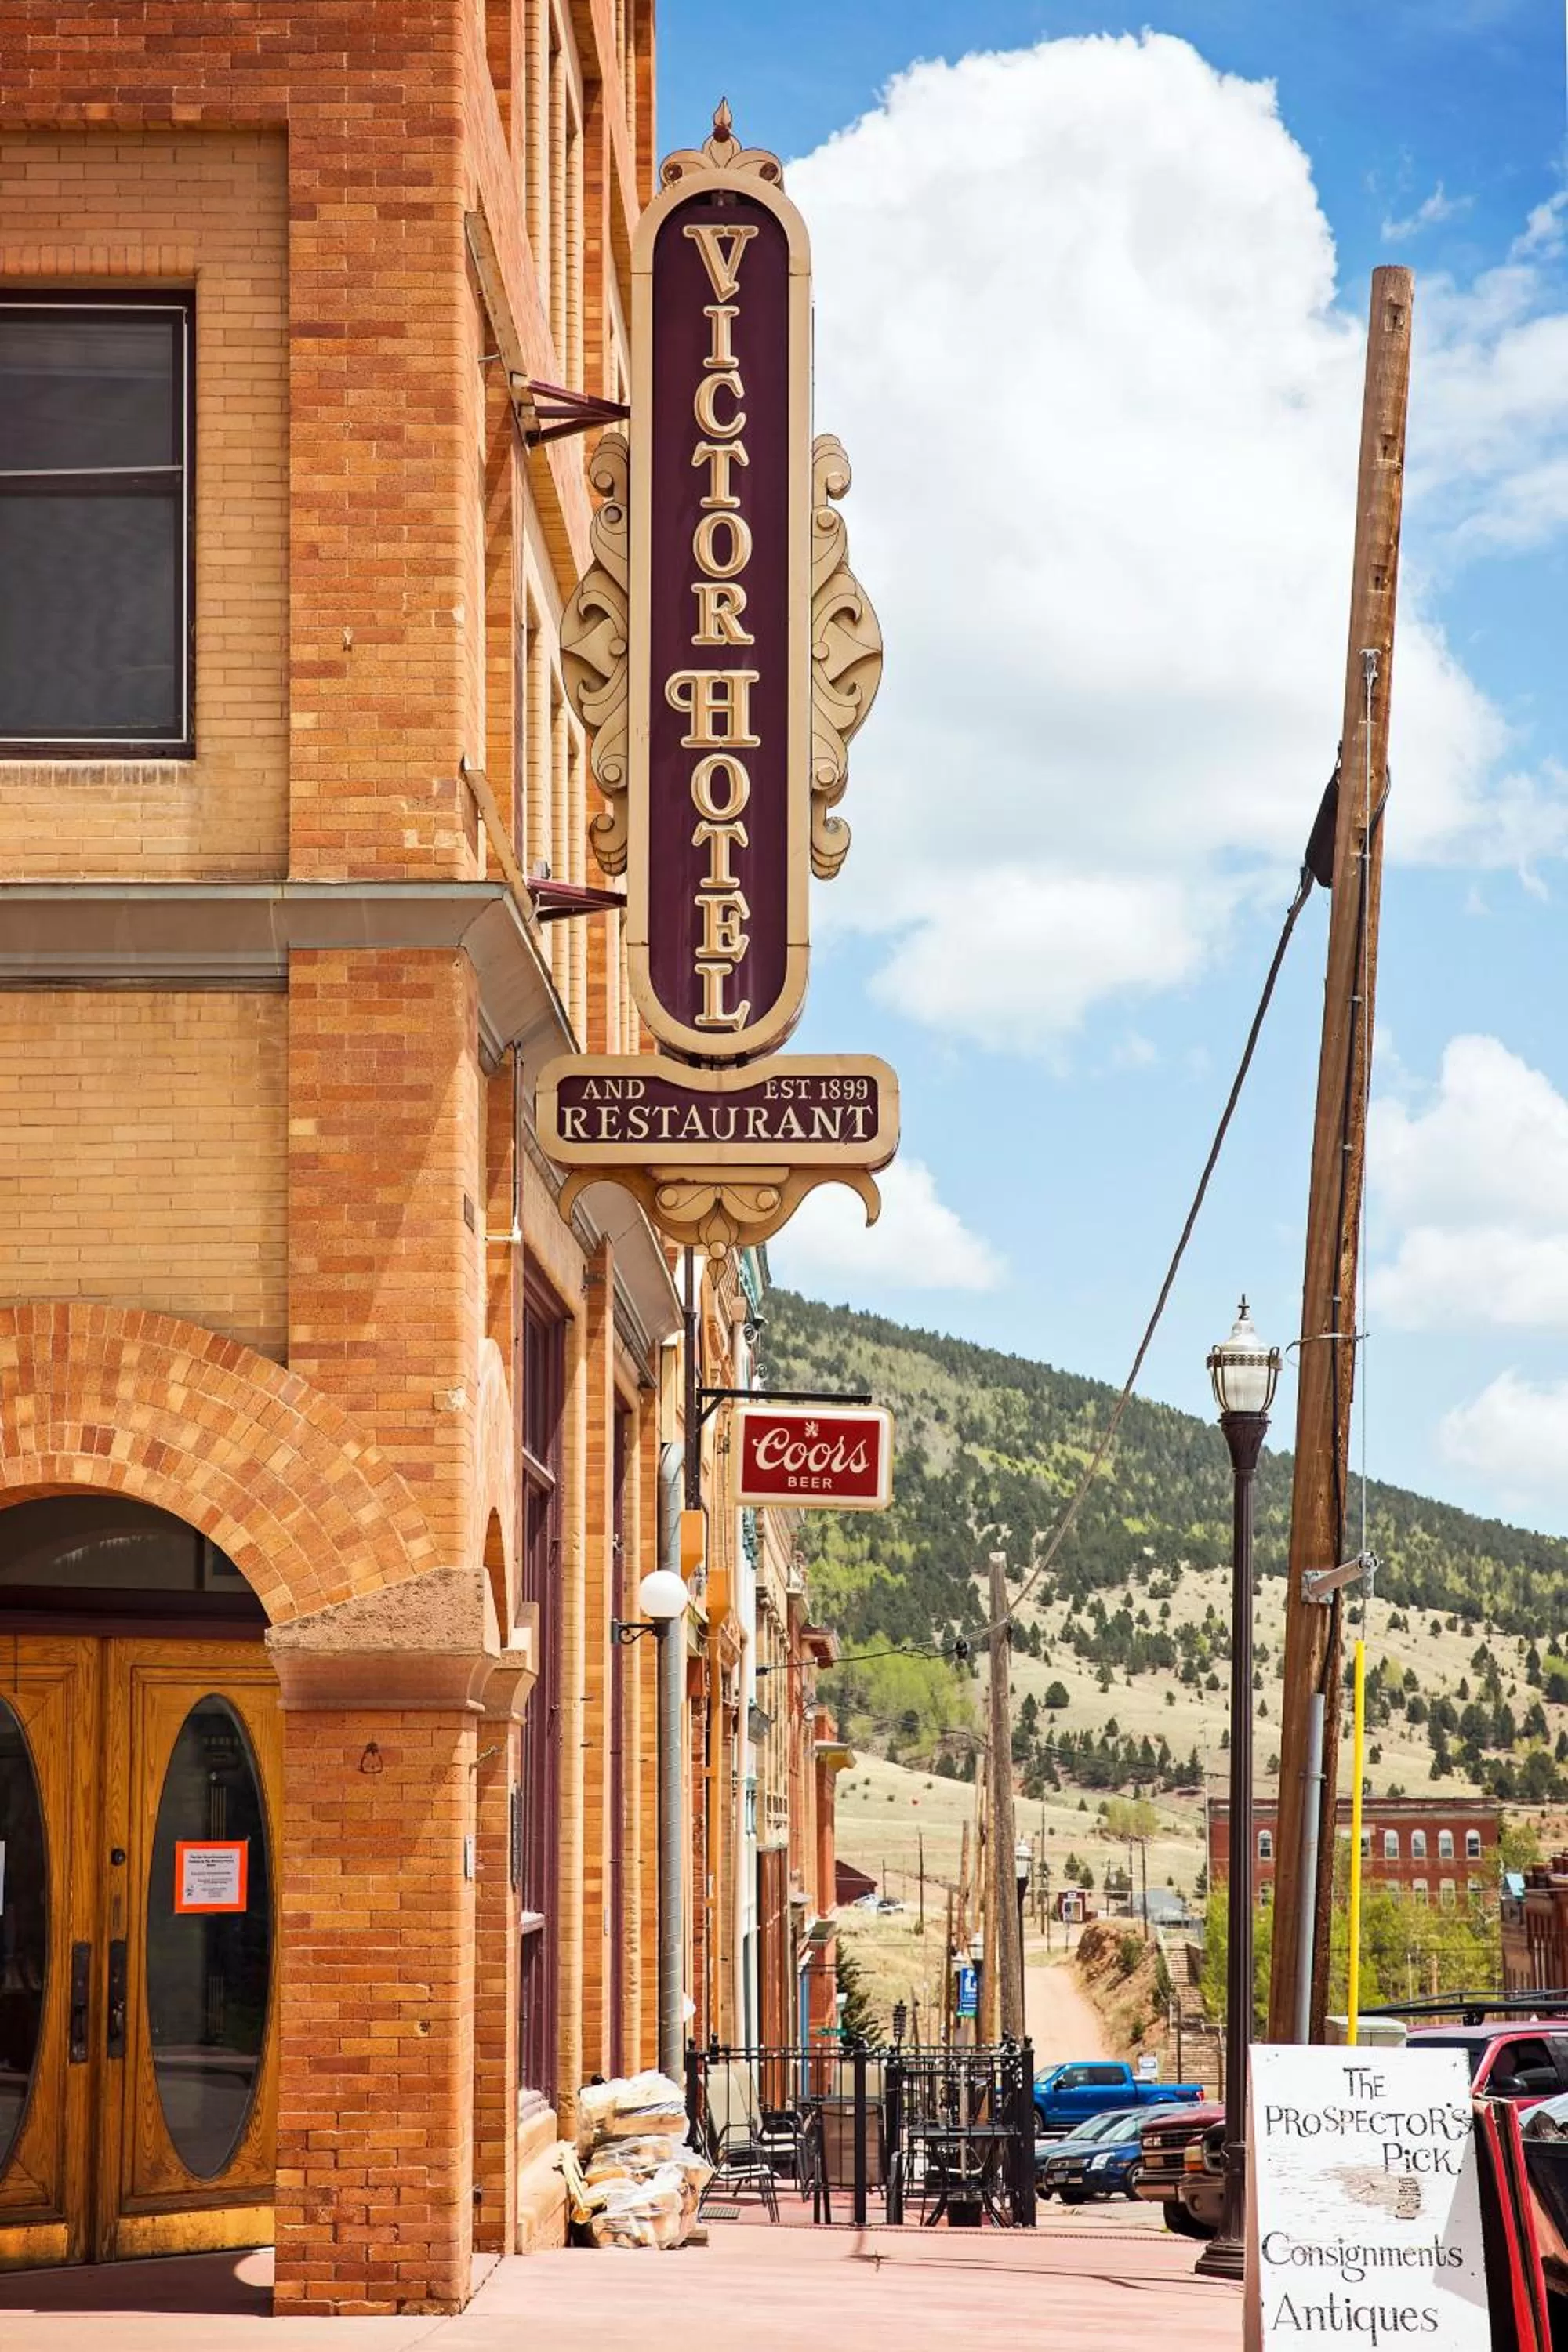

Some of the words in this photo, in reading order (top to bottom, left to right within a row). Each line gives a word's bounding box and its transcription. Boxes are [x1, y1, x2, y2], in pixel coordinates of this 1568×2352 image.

[683, 224, 759, 646] VICTOR
[665, 669, 761, 1032] HOTEL
[581, 1079, 645, 1100] AND
[819, 1078, 869, 1101] 1899
[561, 1104, 873, 1141] RESTAURANT
[752, 1428, 869, 1473] Coors
[788, 1476, 833, 1489] BEER
[1262, 2231, 1464, 2283] Consignments
[1272, 2292, 1439, 2347] Antiques
